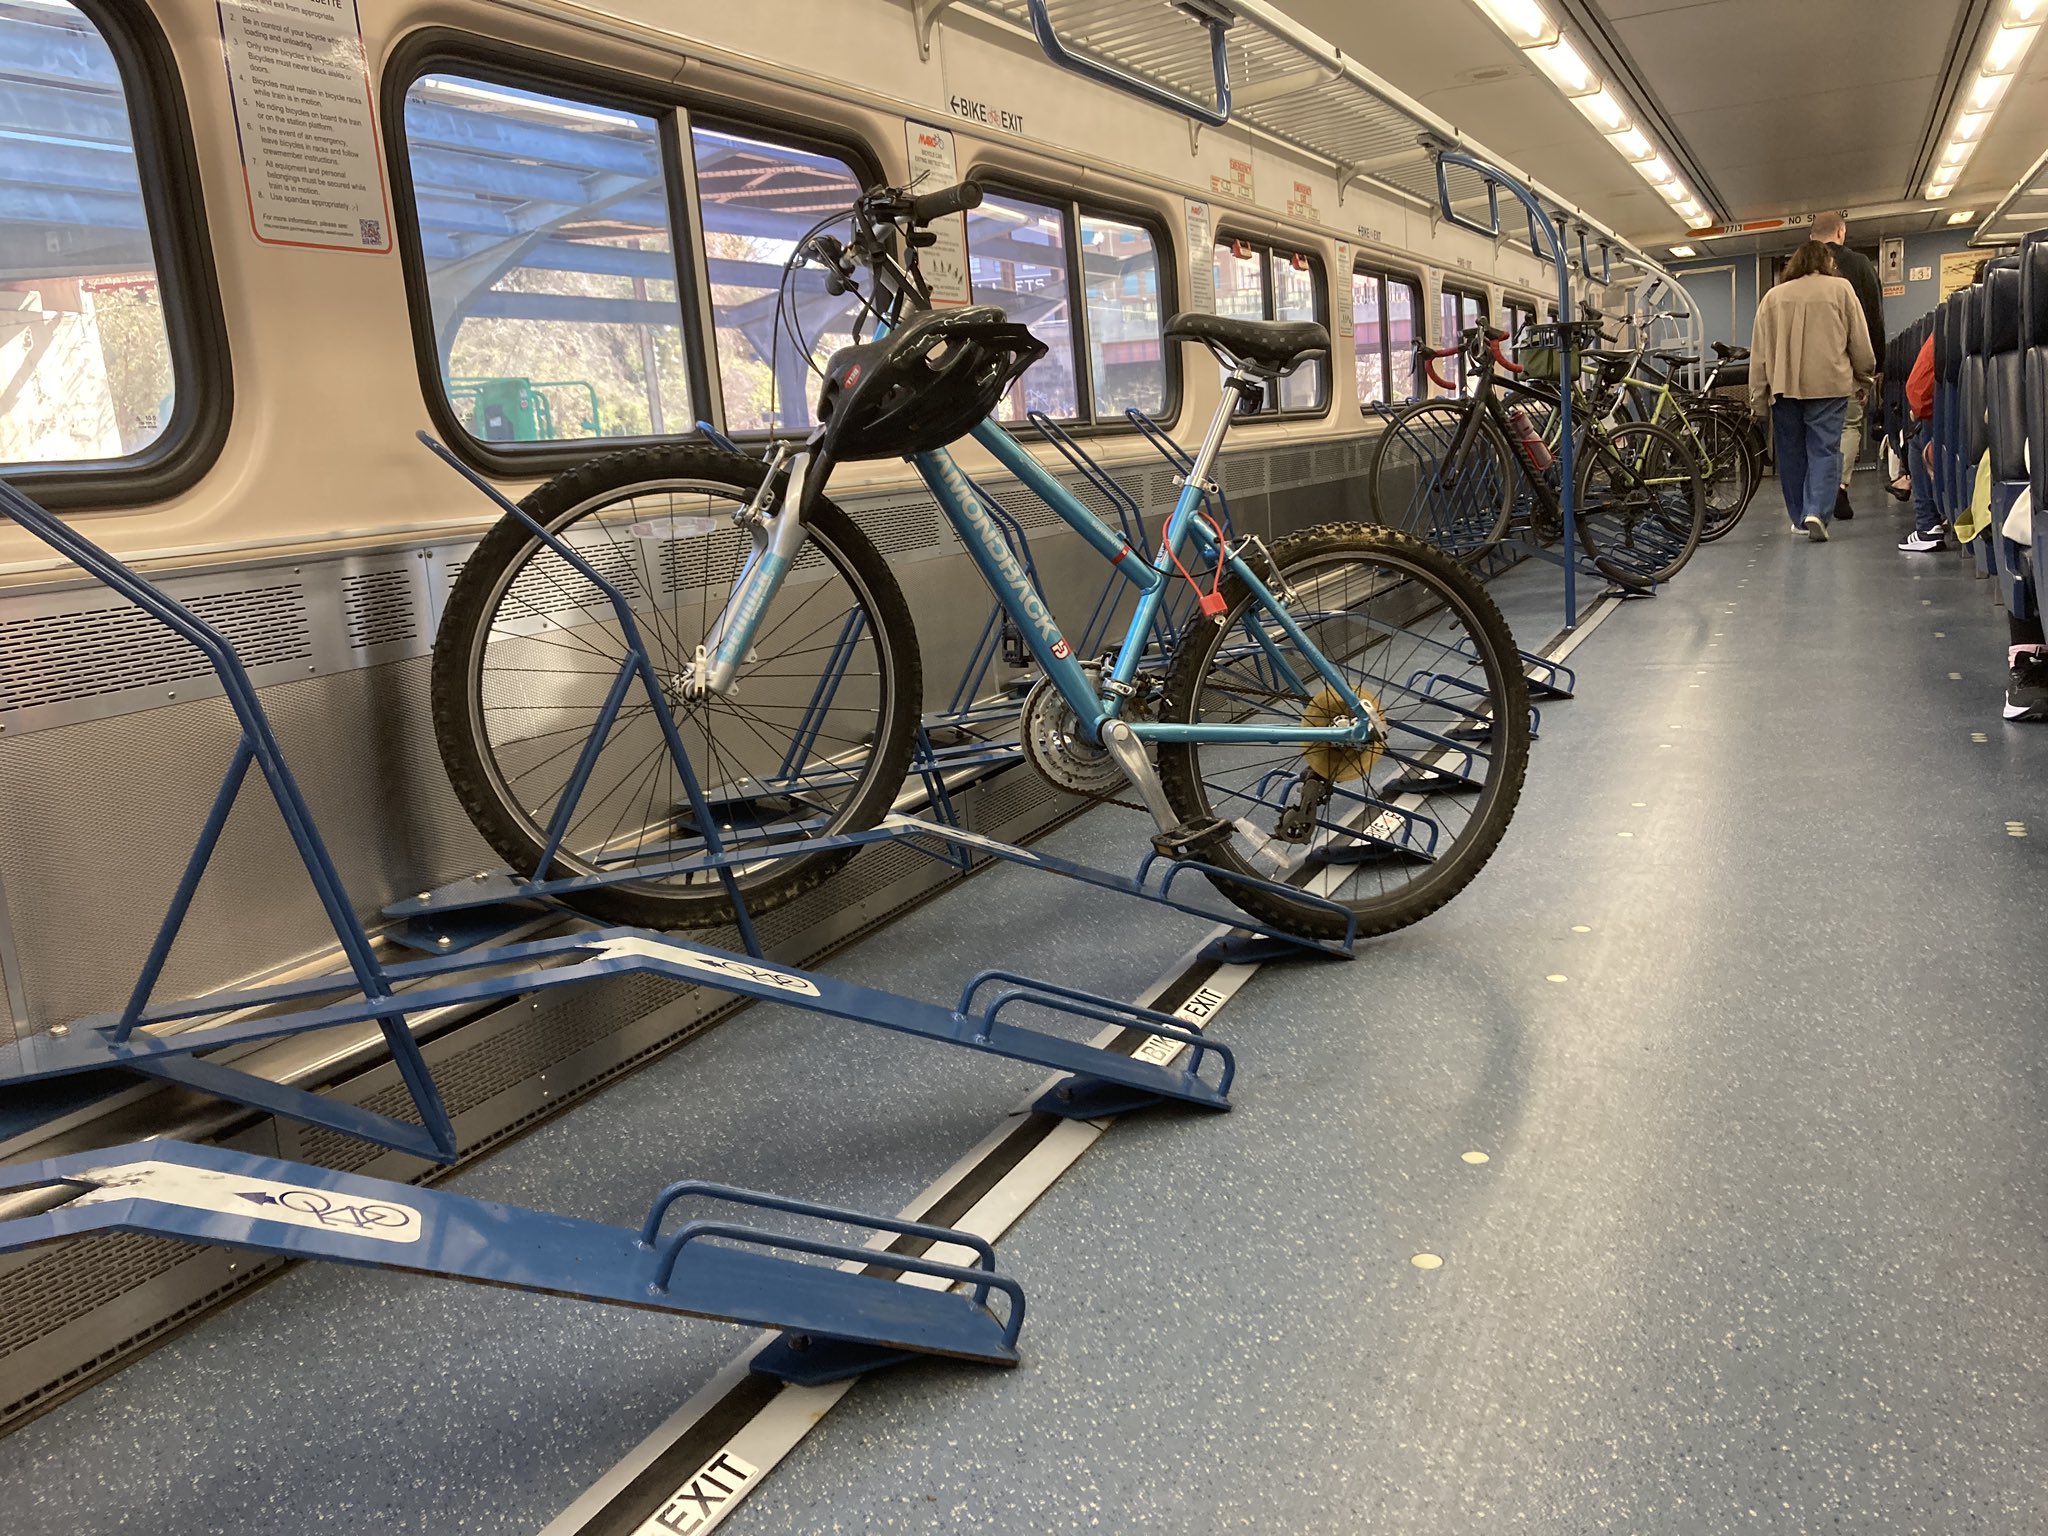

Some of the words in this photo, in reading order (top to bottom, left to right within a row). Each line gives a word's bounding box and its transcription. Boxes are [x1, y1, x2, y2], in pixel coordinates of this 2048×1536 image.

[286, 3, 300, 13] from
[301, 8, 335, 21] appropriate
[242, 16, 252, 25] Be
[261, 20, 282, 32] control
[291, 29, 304, 37] your
[305, 30, 326, 43] bicycle
[244, 27, 268, 40] loading
[269, 33, 281, 42] and
[246, 41, 262, 52] Only
[263, 45, 279, 54] store
[280, 48, 305, 60] bicycles
[247, 52, 275, 64] Bicycles
[276, 58, 292, 68] must
[293, 62, 310, 72] never
[310, 65, 327, 75] block
[252, 76, 279, 88] Bicycles
[280, 83, 295, 92] must
[296, 86, 317, 96] remain
[325, 90, 346, 102] bicycle
[254, 87, 271, 98] while
[271, 90, 286, 100] train
[255, 101, 266, 110] No
[266, 101, 285, 114] riding
[285, 104, 310, 117] bicycles
[320, 113, 337, 122] board
[338, 116, 348, 124] the
[275, 114, 286, 123] the
[286, 117, 307, 127] station
[960, 97, 987, 122] BIKE
[1001, 111, 1023, 133] EXIT
[259, 124, 266, 133] In
[267, 126, 278, 135] the
[279, 129, 296, 138] event
[261, 135, 278, 146] leave
[279, 138, 304, 150] bicycles
[312, 145, 329, 154] racks
[330, 147, 341, 156] and
[342, 149, 359, 158] follow
[263, 147, 303, 160] crewmember
[265, 160, 273, 168] All
[275, 162, 307, 174] equipment
[308, 166, 320, 175] and
[321, 168, 346, 179] personal
[267, 171, 301, 184] belongings
[301, 176, 317, 185] must
[317, 177, 326, 186] be
[327, 179, 350, 189] secured
[351, 182, 366, 191] while
[268, 182, 283, 191] train
[270, 192, 283, 201] Use
[284, 194, 310, 205] spandex
[263, 213, 272, 221] For
[273, 214, 287, 223] more
[320, 220, 337, 229] please
[1725, 224, 1743, 233] 7713
[1788, 217, 1802, 225] NO
[1184, 988, 1222, 1018] EXIT
[654, 1453, 748, 1536] EXIT
